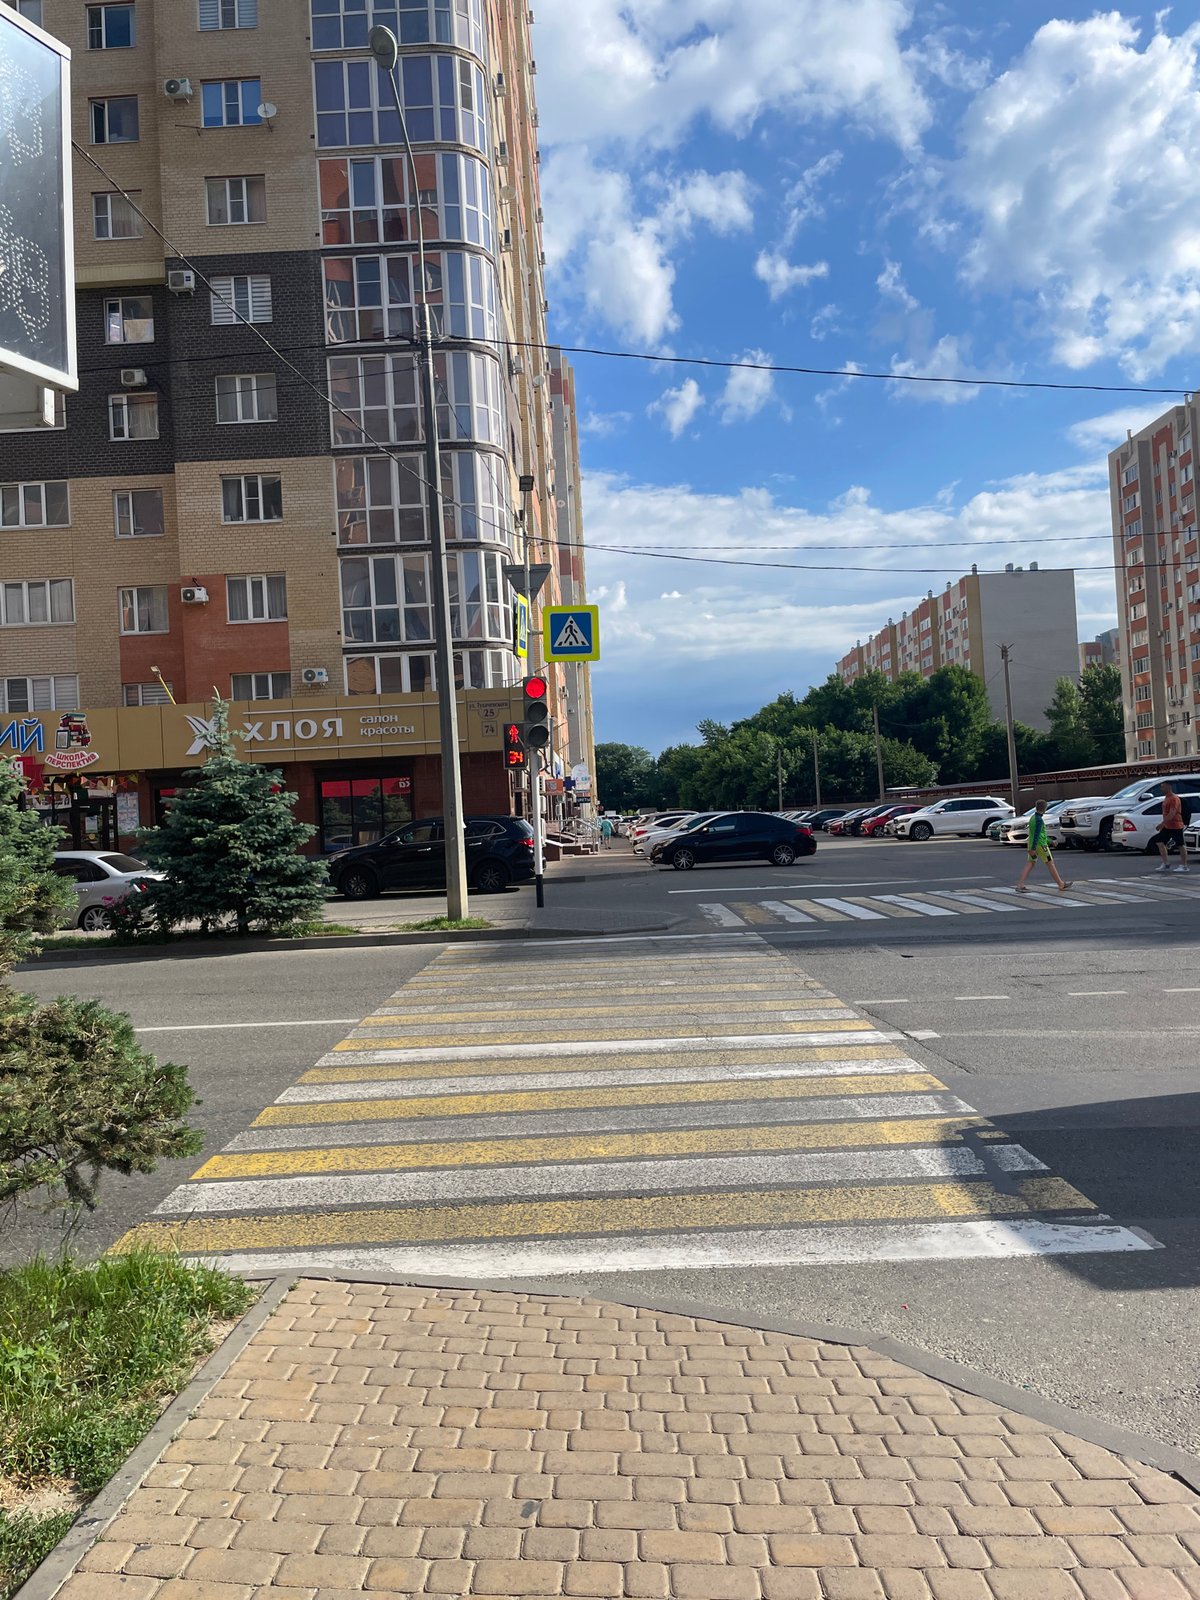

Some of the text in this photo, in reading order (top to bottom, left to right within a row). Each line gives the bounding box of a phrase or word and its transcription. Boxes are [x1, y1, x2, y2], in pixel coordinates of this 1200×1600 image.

[484, 708, 495, 717] 25
[359, 714, 398, 724] салон
[360, 725, 415, 737] красоты
[484, 724, 495, 734] 74
[46, 753, 97, 768] ПЕРСПЕКТИВ
[56, 752, 86, 761] ШКОЛА
[509, 751, 524, 764] 34
